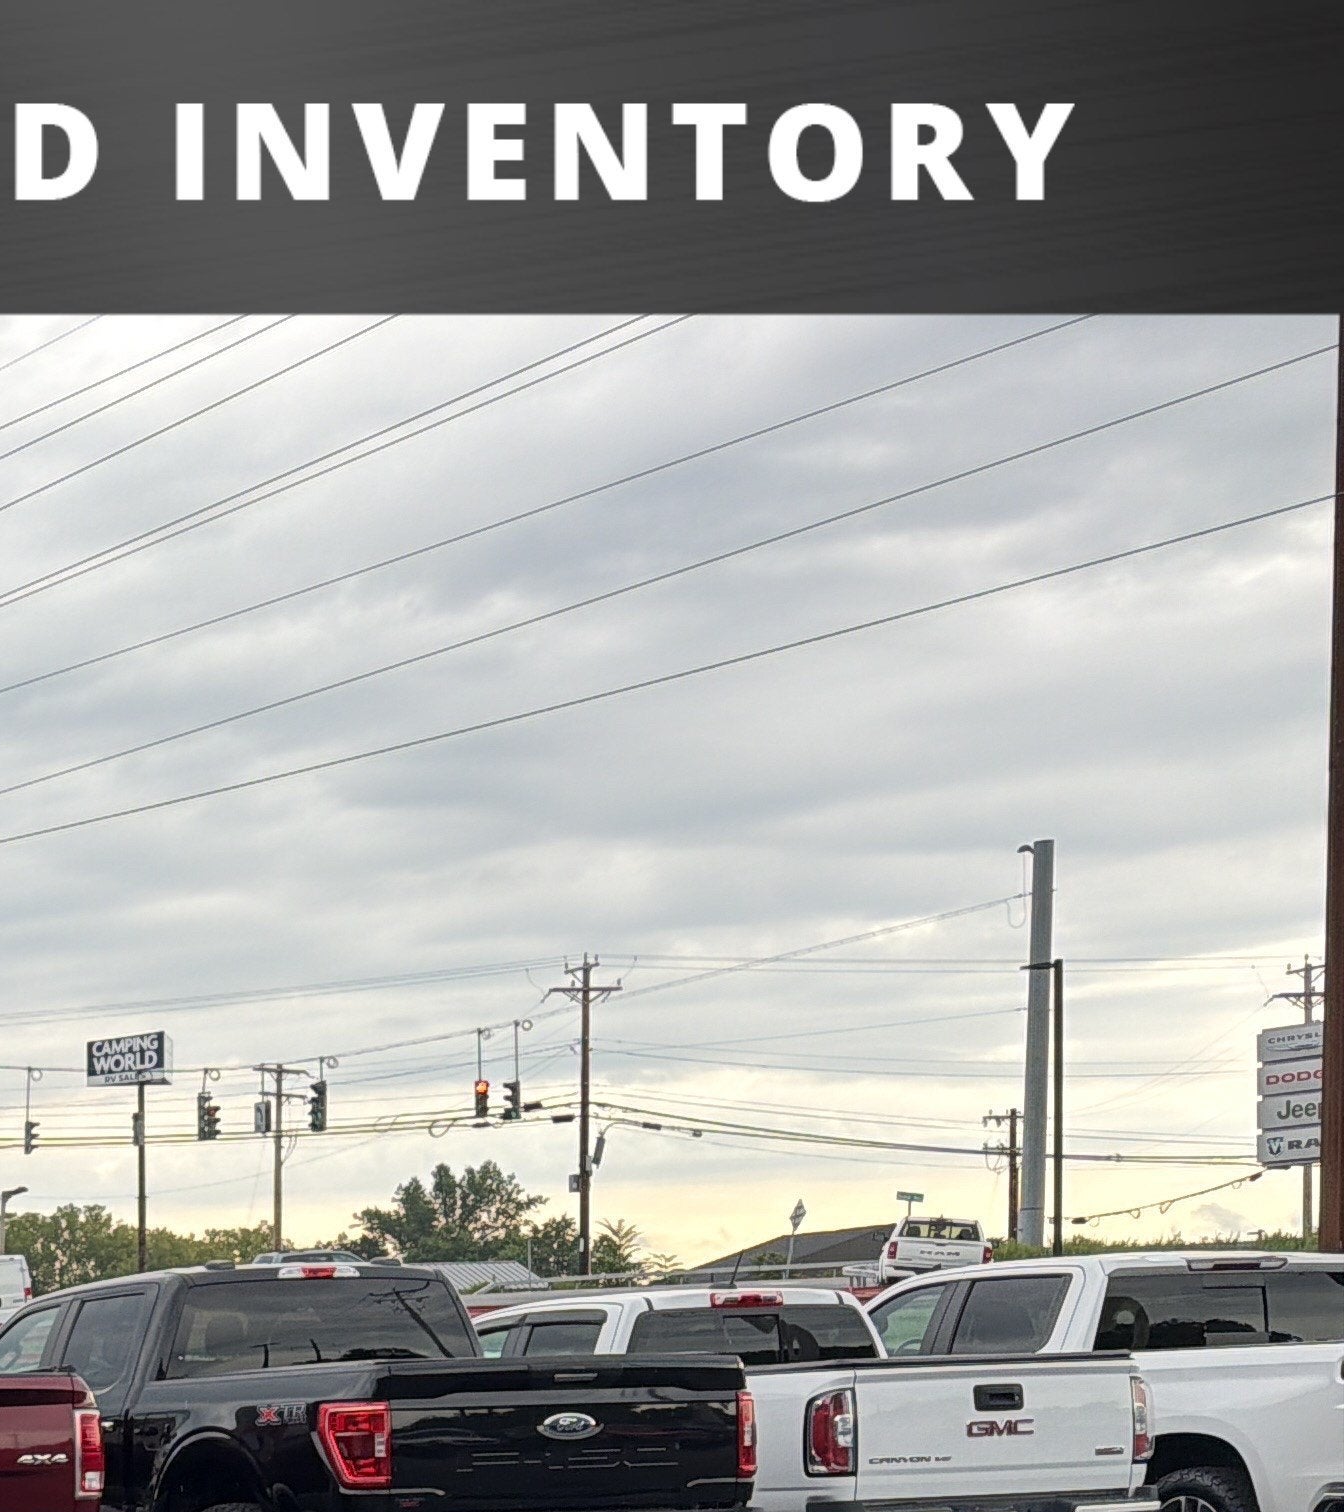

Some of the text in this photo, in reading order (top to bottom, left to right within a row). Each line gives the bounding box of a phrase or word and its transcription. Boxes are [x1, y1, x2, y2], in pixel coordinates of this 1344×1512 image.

[92, 1035, 159, 1057] CAMPING
[92, 1050, 158, 1075] WORLD
[967, 1418, 1035, 1438] GMC
